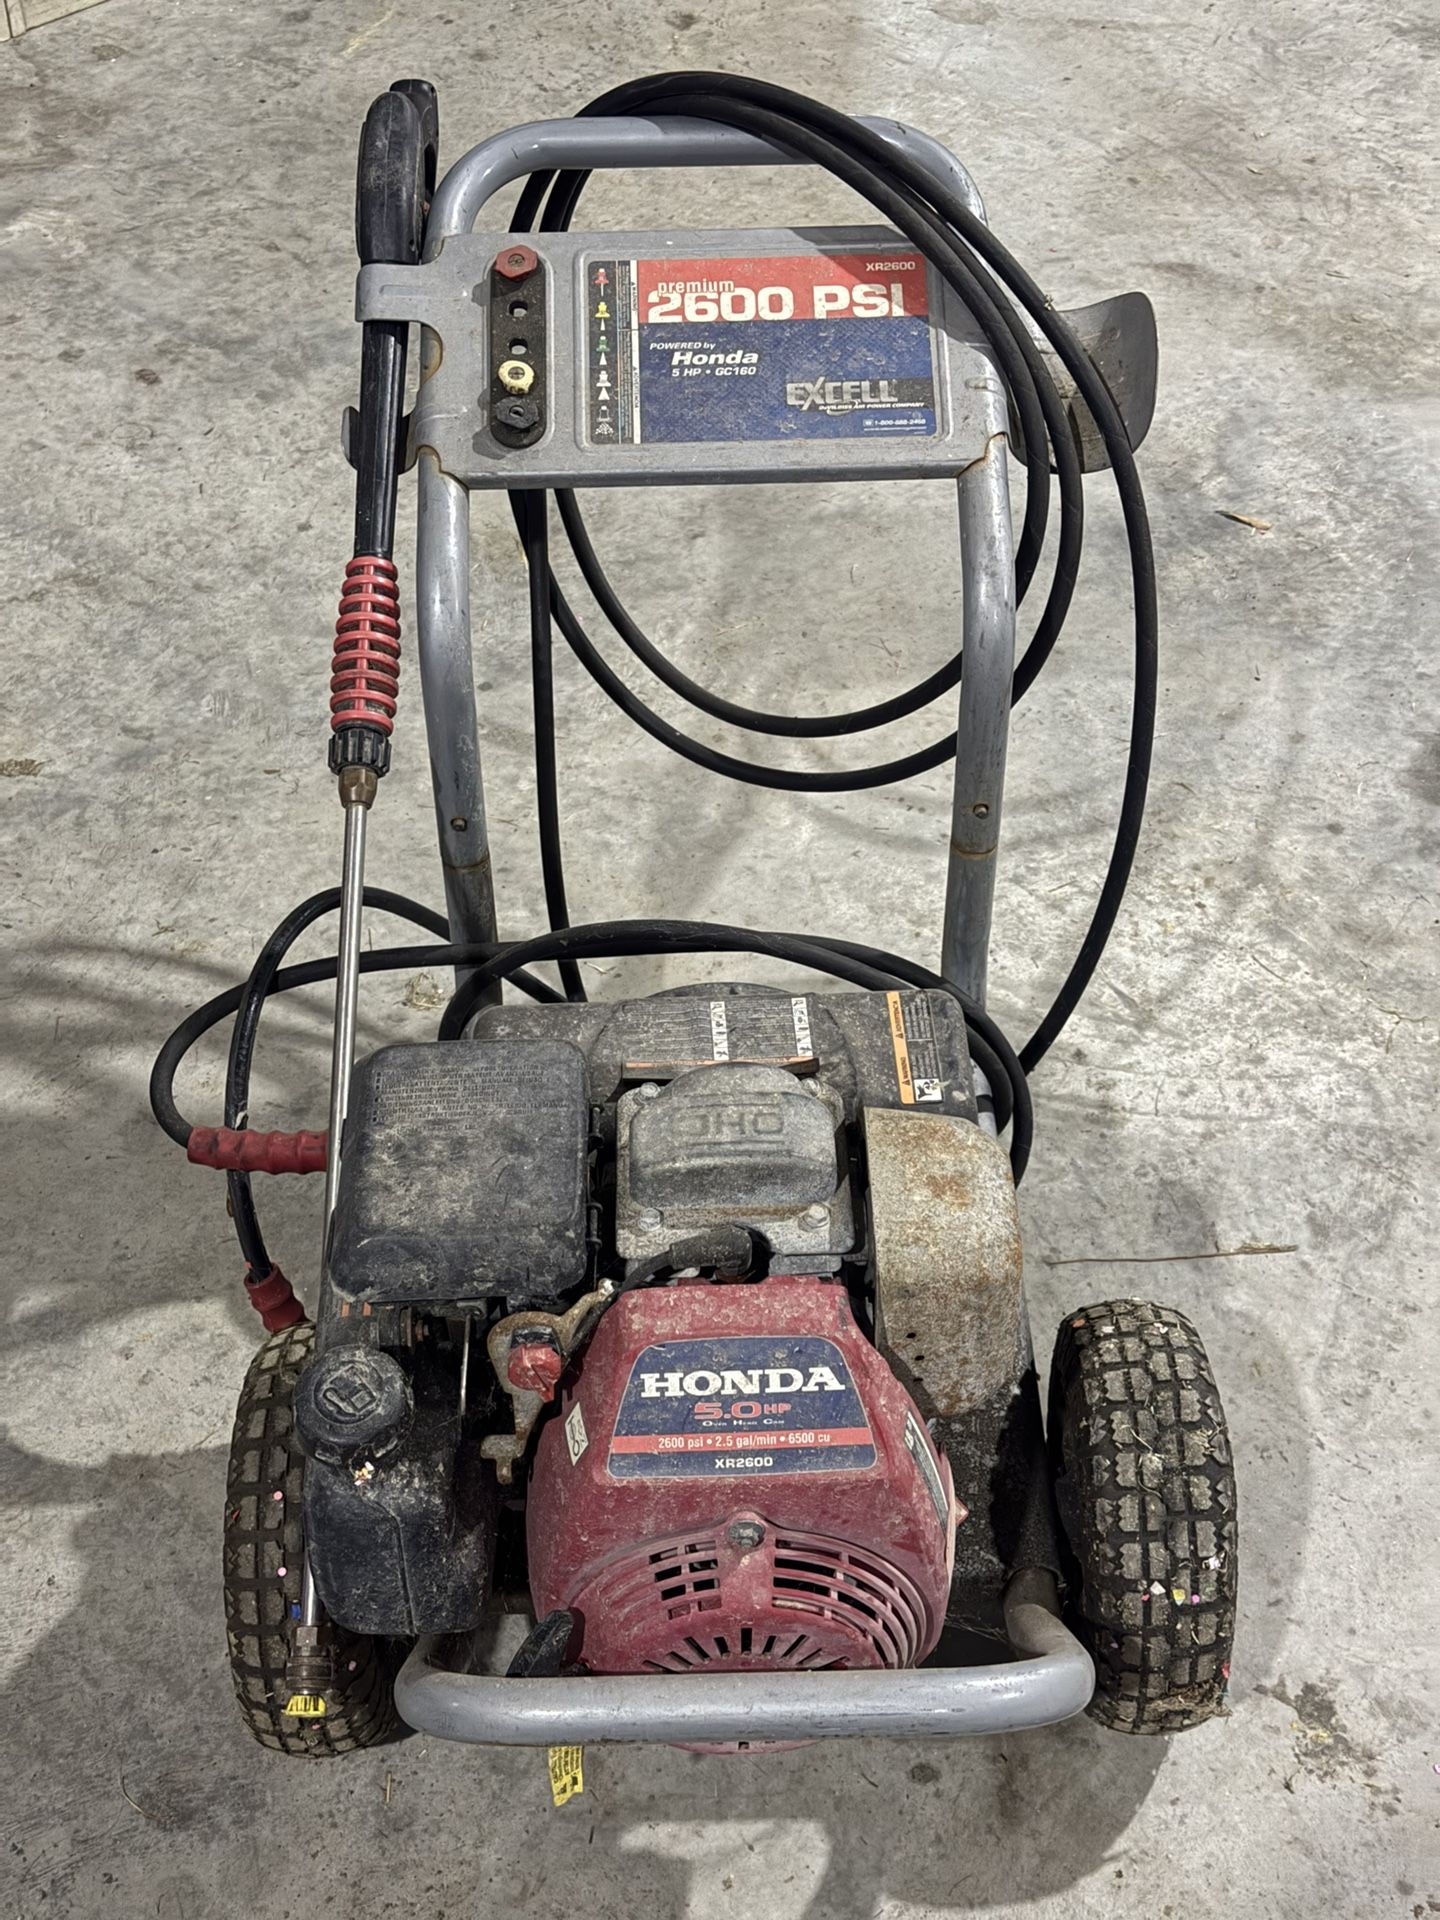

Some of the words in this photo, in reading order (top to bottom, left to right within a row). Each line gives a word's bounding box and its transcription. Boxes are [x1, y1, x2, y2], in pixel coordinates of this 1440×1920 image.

[865, 260, 917, 272] XR2600
[657, 277, 735, 297] premium
[647, 288, 795, 325] 2600
[812, 282, 906, 320] PSI
[649, 341, 702, 351] POWERED
[703, 341, 716, 352] by
[671, 350, 760, 366] Honda
[671, 367, 681, 377] 5
[683, 367, 703, 377] HP
[714, 365, 758, 377] GC160
[866, 402, 893, 410] POWER
[892, 401, 926, 409] COMPANY
[639, 1365, 846, 1398] HONDA
[658, 1436, 685, 1449] 2600
[687, 1435, 705, 1450] psi
[715, 1434, 734, 1447] 2.5
[736, 1433, 777, 1448] gal/min
[788, 1431, 815, 1444] 6500
[817, 1434, 832, 1443] cu
[714, 1455, 774, 1470] XR2600
